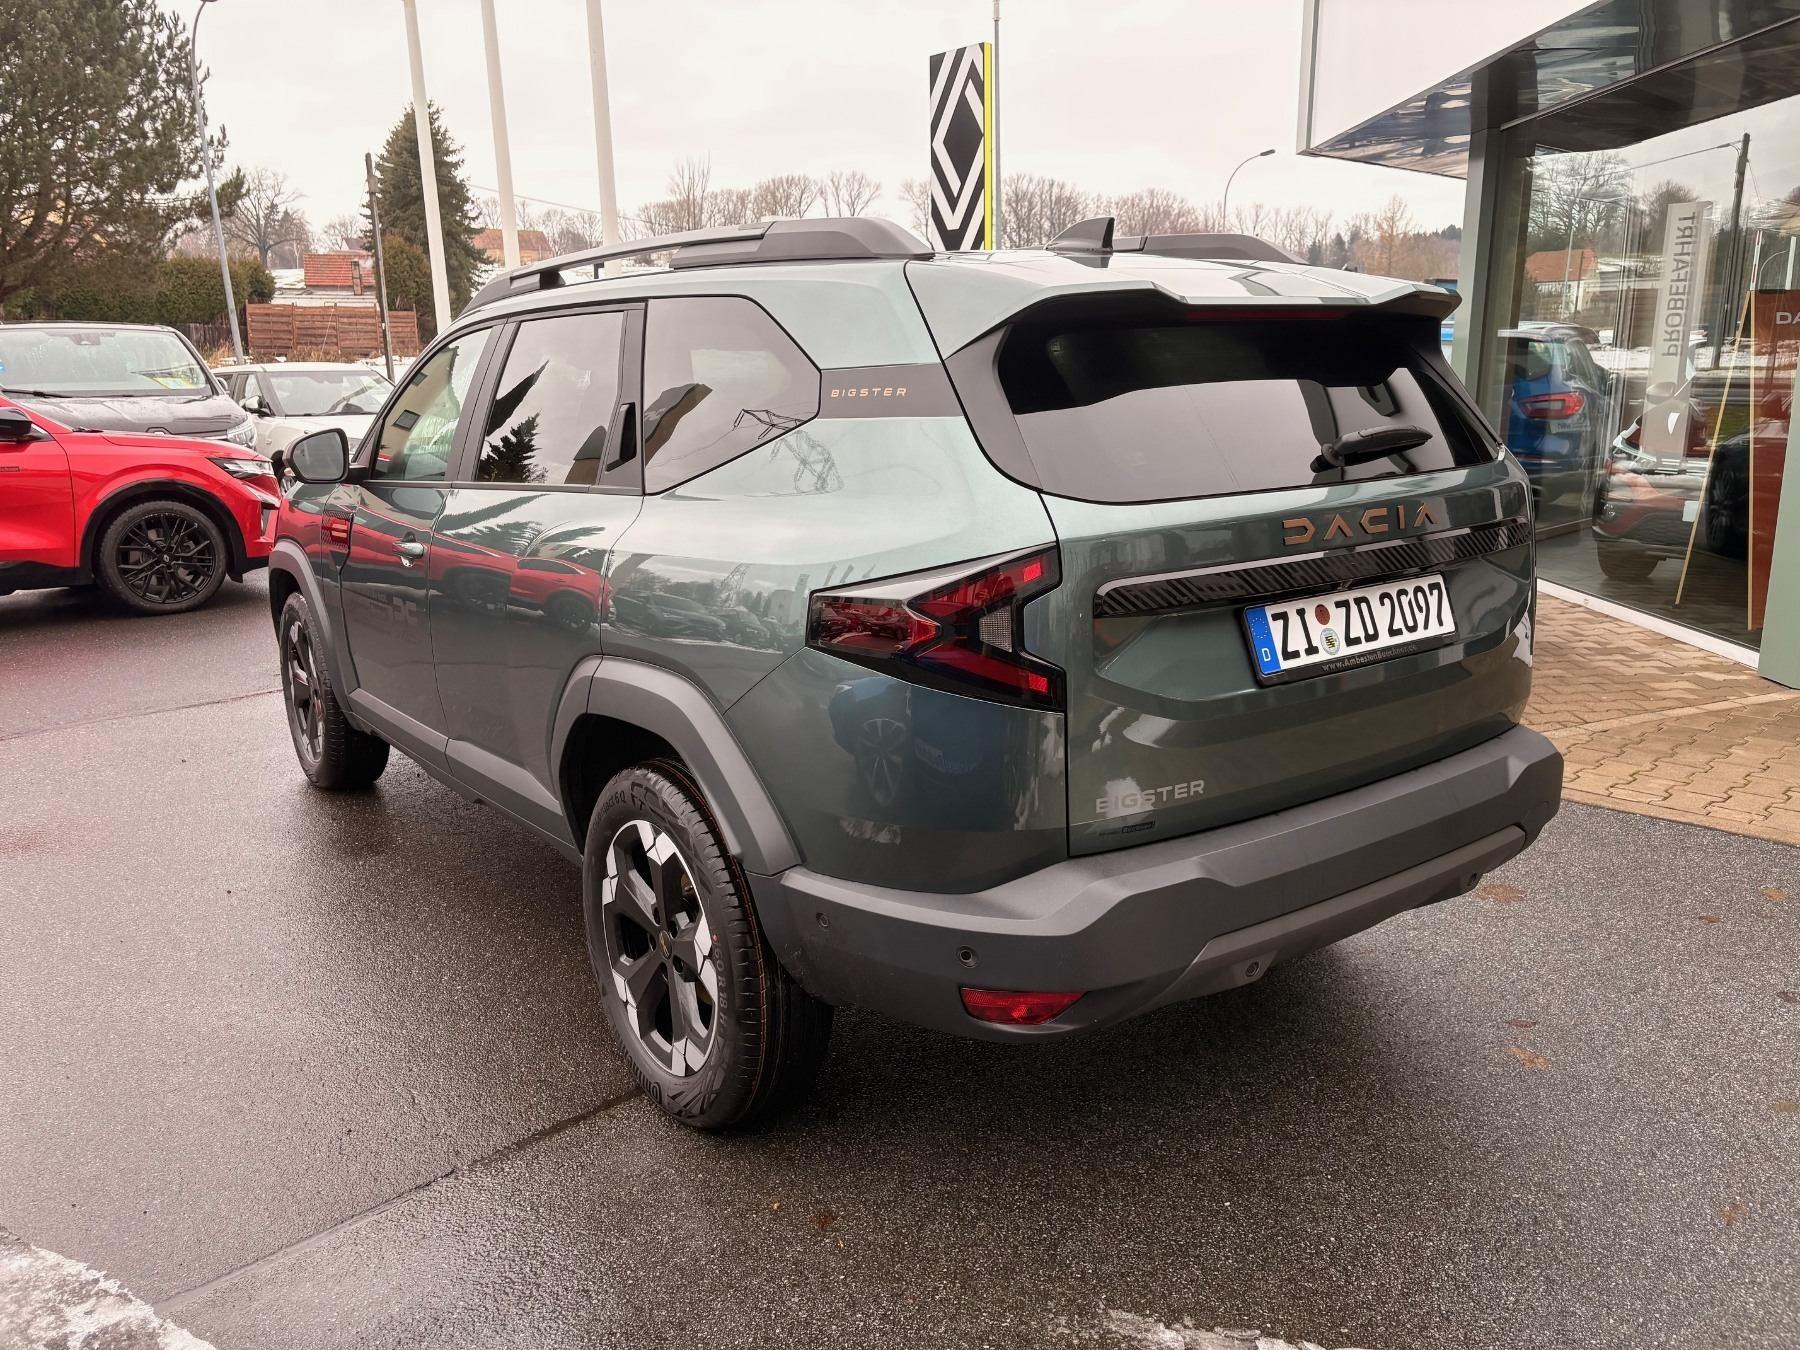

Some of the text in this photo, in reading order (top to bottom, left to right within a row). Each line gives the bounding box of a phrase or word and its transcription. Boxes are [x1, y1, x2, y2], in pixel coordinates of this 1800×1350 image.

[830, 387, 907, 398] BIGSTER
[1282, 502, 1440, 546] DACIA
[1270, 581, 1444, 662] ZI ZD 2097
[1261, 647, 1271, 662] D
[1095, 779, 1205, 814] BIGSTER
